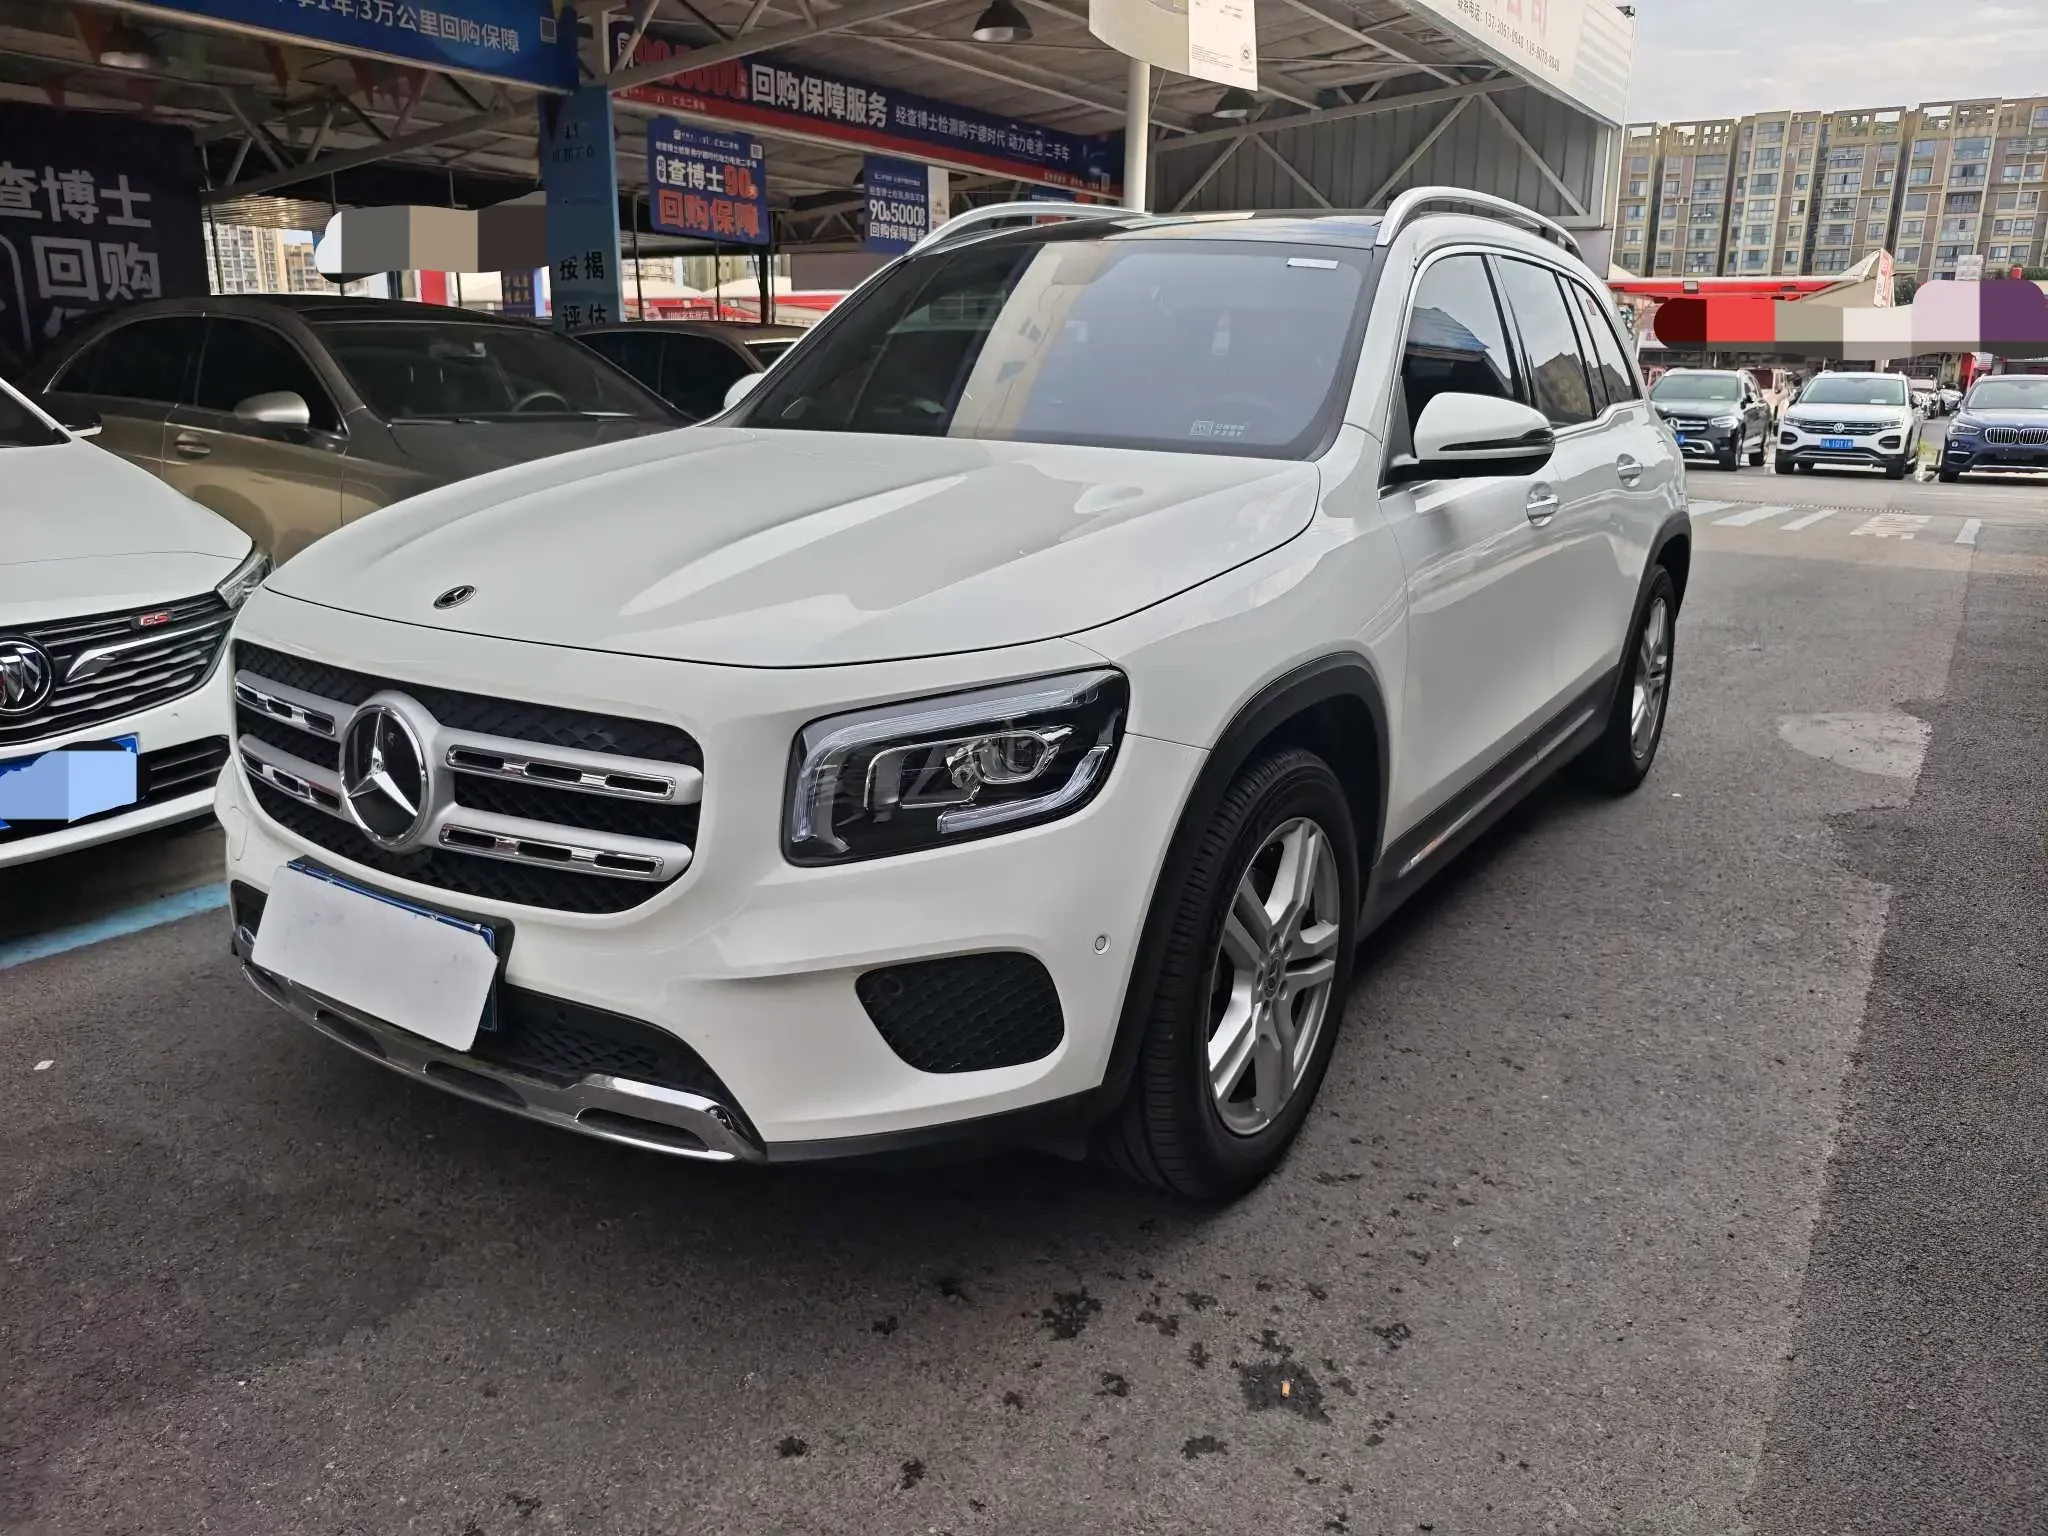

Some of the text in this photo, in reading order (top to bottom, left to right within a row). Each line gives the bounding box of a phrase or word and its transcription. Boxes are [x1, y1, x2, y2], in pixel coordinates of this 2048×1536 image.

[752, 63, 888, 129] 回购保障服务
[0, 161, 152, 228] 查博士
[658, 189, 759, 238] 回购保障
[31, 235, 161, 301] 回购
[560, 251, 605, 281] 按揭
[563, 303, 608, 328] 评估
